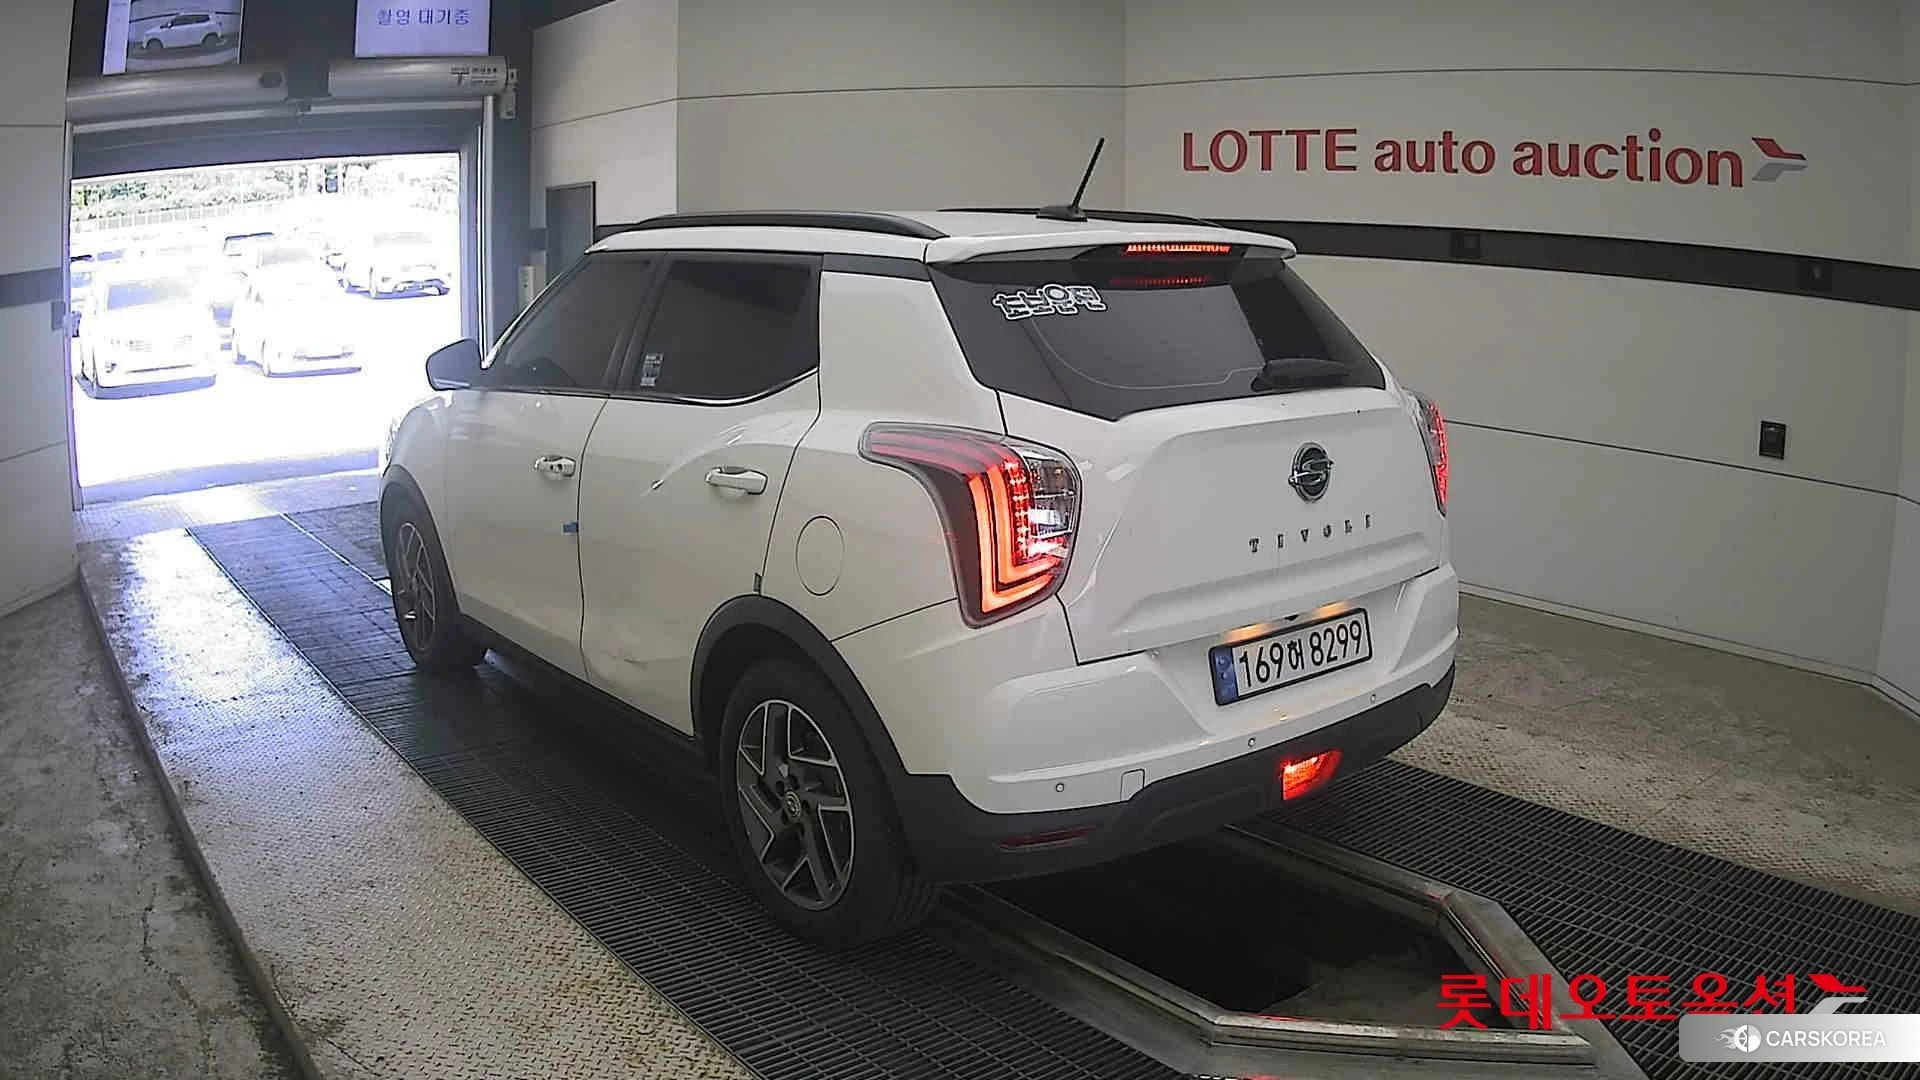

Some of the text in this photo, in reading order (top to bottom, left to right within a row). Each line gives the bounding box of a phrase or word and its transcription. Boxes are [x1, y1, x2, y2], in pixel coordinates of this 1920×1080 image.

[418, 8, 470, 26] 대기중
[1183, 128, 1744, 188] LOTTE auto auction
[1249, 514, 1371, 553] TIVOLI
[1239, 620, 1362, 687] 169허 8299
